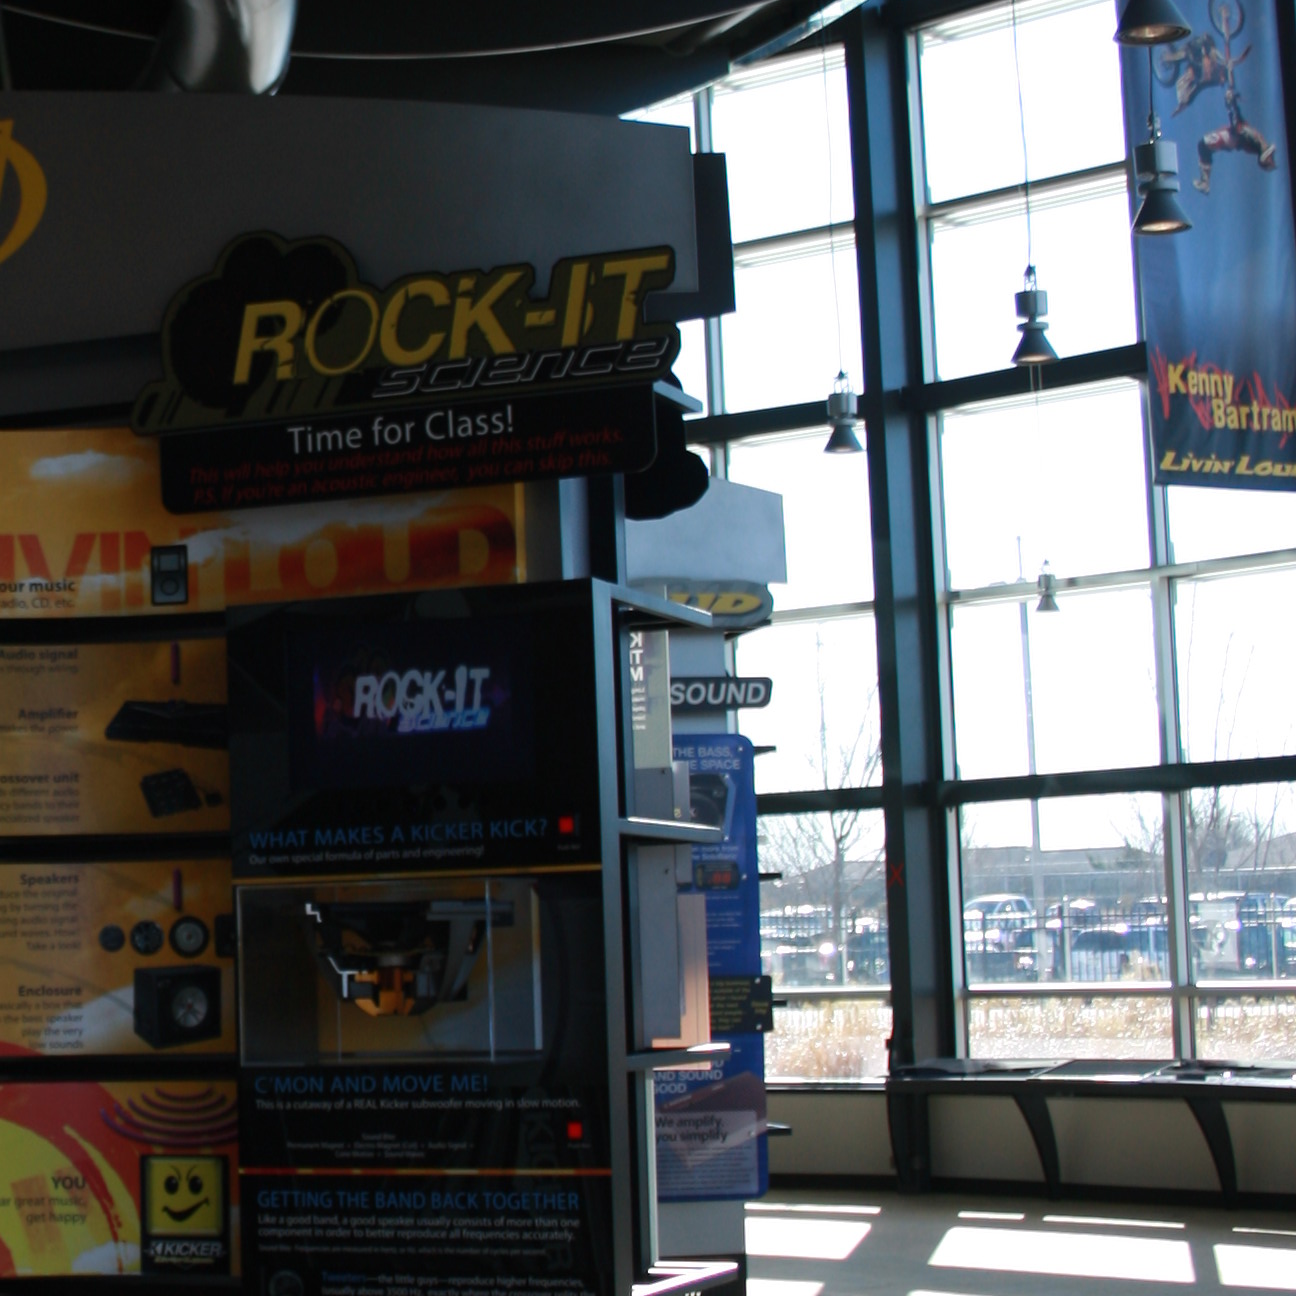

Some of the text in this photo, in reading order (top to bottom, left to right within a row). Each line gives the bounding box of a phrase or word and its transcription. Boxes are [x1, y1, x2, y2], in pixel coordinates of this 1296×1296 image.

[232, 253, 671, 387] ROCK-IT
[371, 335, 671, 399] science
[1167, 363, 1235, 405] Kenny
[286, 403, 514, 455] Time for Class!
[189, 463, 220, 484] This
[223, 459, 252, 481] will
[254, 456, 291, 481] help
[294, 458, 325, 481] you
[327, 445, 424, 470] understand
[426, 441, 465, 462] how
[466, 437, 488, 458] all
[490, 435, 522, 455] this
[526, 430, 568, 451] stuff
[287, 480, 308, 497] an
[310, 472, 378, 495] acoustic
[467, 461, 500, 483] you
[503, 457, 535, 475] can
[538, 450, 575, 474] skip
[222, 506, 518, 602] LOUD
[29, 580, 76, 593] music
[38, 647, 78, 663] signal
[353, 664, 491, 720] ROCK-IT
[670, 681, 766, 706] SOUND
[18, 708, 79, 722] Amplifier
[700, 760, 741, 771] SPACE
[53, 772, 80, 783] unit
[248, 818, 547, 849] WHAT MAKES A KICKER KICK?
[249, 845, 484, 865] Our own special formula of parts and engineering!
[20, 873, 80, 886] Speakers
[26, 942, 47, 951] Take
[18, 985, 82, 997] Enclosure
[46, 1013, 83, 1024] speaker
[22, 1027, 83, 1038] play the very
[49, 1040, 83, 1049] sounds
[678, 1069, 724, 1081] SOUND
[254, 1073, 488, 1094] C'MON AND MOVE ME!
[255, 1098, 275, 1110] This
[293, 1099, 333, 1112] cutaway
[334, 1098, 345, 1110] of
[411, 1098, 462, 1109] subwoofer
[464, 1098, 503, 1111] moving
[505, 1098, 515, 1108] in
[517, 1097, 540, 1109] slow
[542, 1097, 581, 1109] motion.
[655, 1116, 675, 1128] We
[655, 1129, 728, 1144] you simplify
[51, 1176, 86, 1190] YOU
[14, 1197, 45, 1210] great
[257, 1190, 580, 1211] GETTING THE BAND BACK TOGETHER
[26, 1212, 88, 1225] get happy
[257, 1214, 278, 1225] Like
[286, 1215, 311, 1227] good
[313, 1214, 339, 1226] band,
[350, 1215, 376, 1227] good
[377, 1215, 415, 1228] speaker
[416, 1216, 451, 1230] usually
[452, 1217, 492, 1228] consists
[494, 1216, 505, 1227] of
[506, 1218, 533, 1228] more
[535, 1217, 558, 1228] than
[560, 1219, 580, 1228] one
[258, 1227, 575, 1242] component in order to better reproduce all frequencies accurately.
[164, 1241, 223, 1258] KICKER
